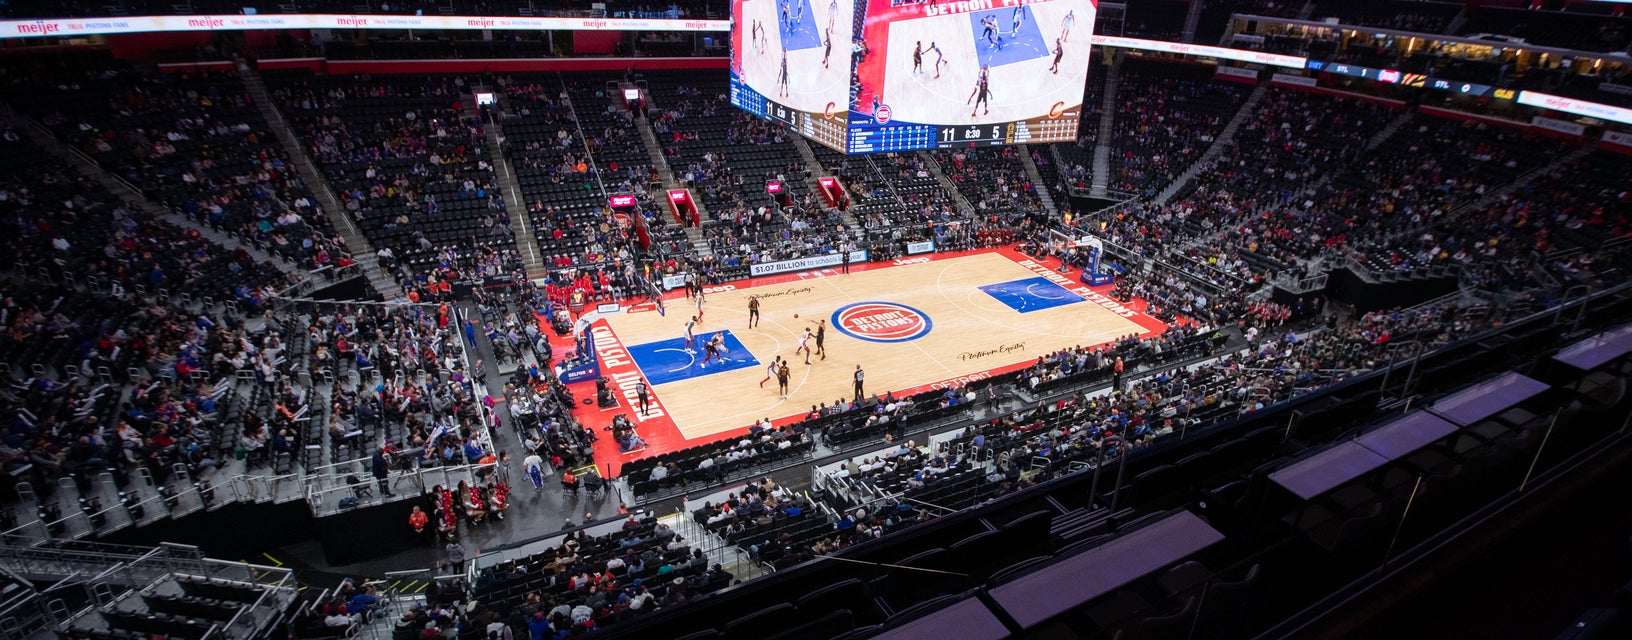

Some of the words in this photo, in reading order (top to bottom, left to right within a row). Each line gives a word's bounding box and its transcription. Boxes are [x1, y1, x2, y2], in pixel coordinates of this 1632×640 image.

[17, 21, 60, 35] meijer
[188, 16, 225, 29] meijer
[337, 15, 368, 28] meijer
[467, 17, 495, 28] meijer
[583, 18, 607, 29] meijer
[685, 20, 707, 30] meijer
[1170, 43, 1190, 53] meijer
[766, 101, 774, 115] 11
[790, 111, 796, 125] 5
[942, 127, 956, 142] 11
[965, 129, 981, 139] 8:30
[992, 125, 1000, 138] 5
[755, 265, 774, 274] $1.07
[776, 260, 806, 271] BILLION
[815, 256, 837, 265] schools
[893, 257, 930, 266] Jeep
[1018, 259, 1076, 286] DETROIT
[697, 284, 736, 296] eep
[1072, 286, 1139, 318] PISTONS
[849, 311, 904, 325] DETROIT
[857, 316, 914, 332] PISTONS
[591, 325, 632, 369] PISTONS
[957, 348, 998, 361] Platinum
[999, 342, 1026, 354] Equity
[568, 369, 587, 378] BELFOR
